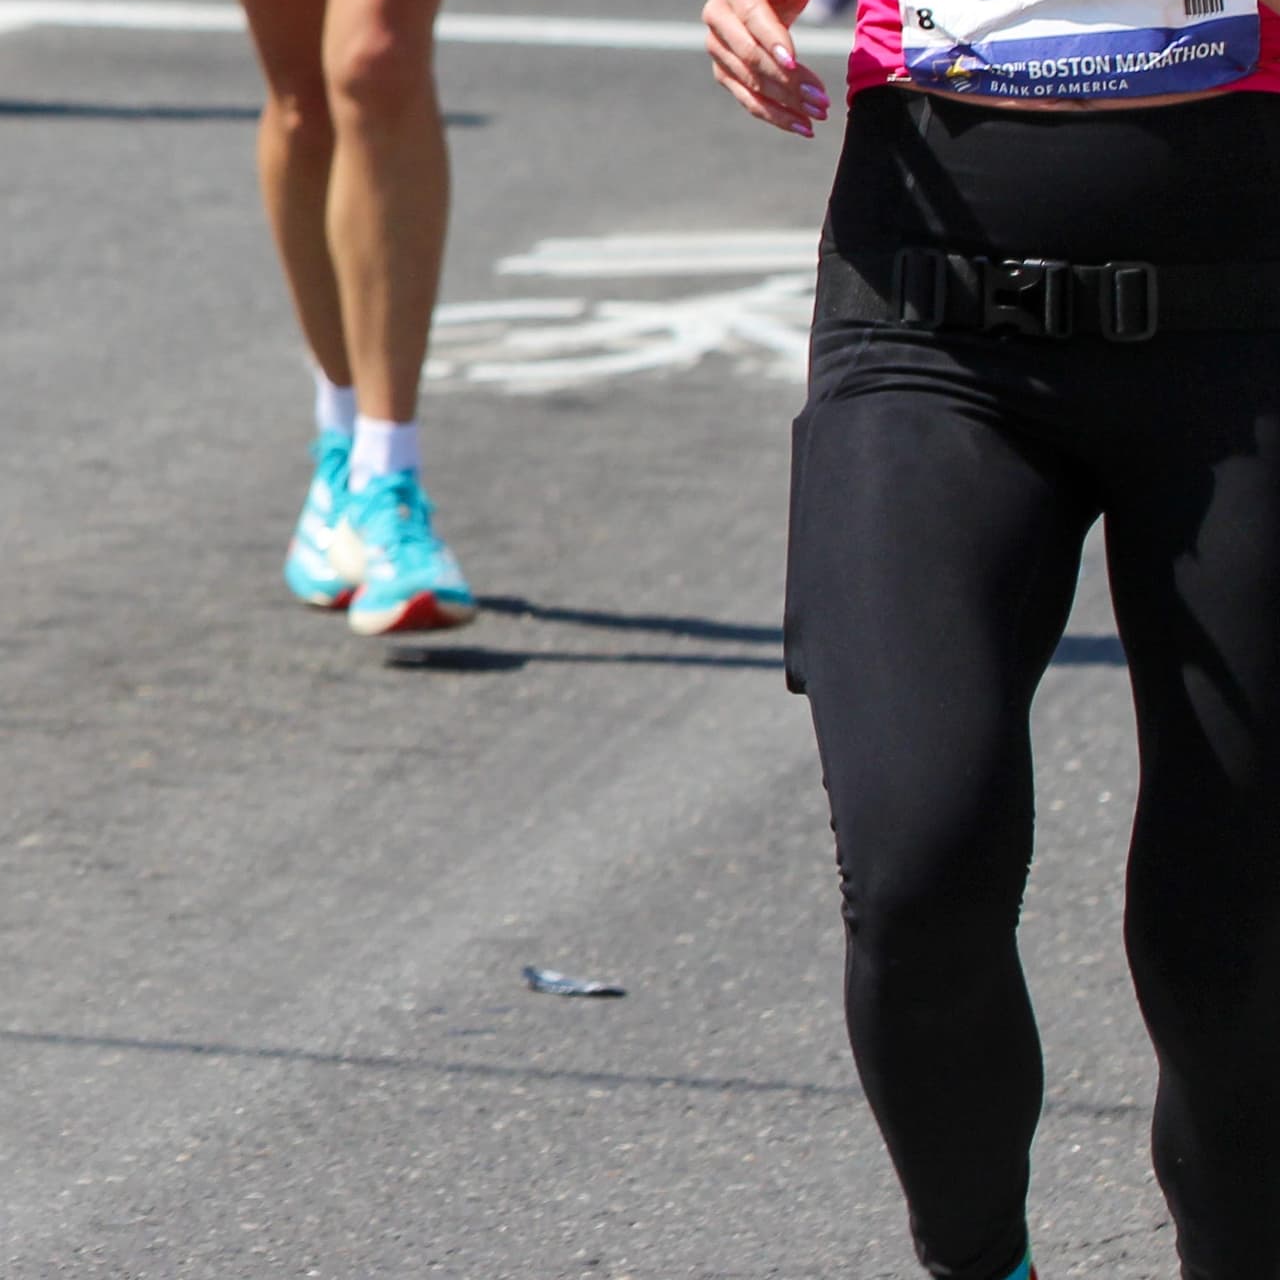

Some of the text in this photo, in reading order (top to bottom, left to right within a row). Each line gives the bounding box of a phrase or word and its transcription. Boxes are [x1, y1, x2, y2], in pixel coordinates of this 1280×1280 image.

[917, 8, 934, 31] 8
[1028, 55, 1111, 79] BOSTON
[1115, 40, 1226, 73] MARATHON
[990, 78, 1130, 96] BANK OF AMERICA
